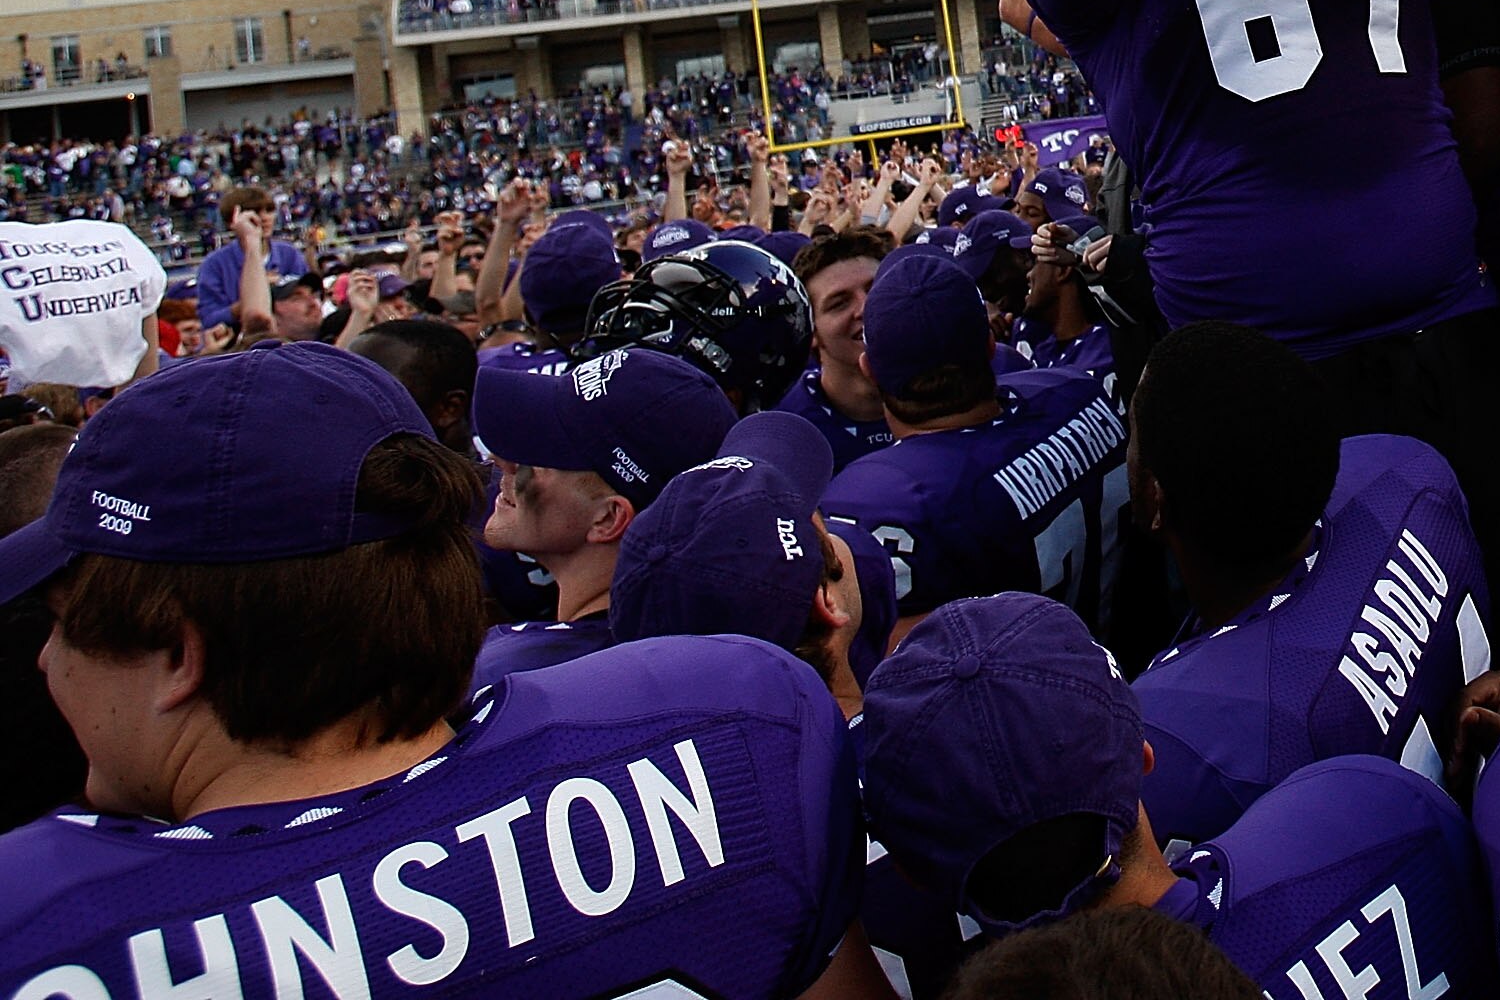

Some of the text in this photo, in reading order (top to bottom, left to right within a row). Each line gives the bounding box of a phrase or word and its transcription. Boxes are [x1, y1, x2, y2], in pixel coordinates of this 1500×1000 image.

[866, 433, 894, 445] TCU
[611, 462, 635, 483] 2009
[612, 446, 650, 484] FOOTBALL
[993, 396, 1128, 521] KIRKPATRICK
[92, 490, 151, 522] FOOTBALL
[99, 513, 132, 535] 2009
[777, 517, 803, 560] TCU
